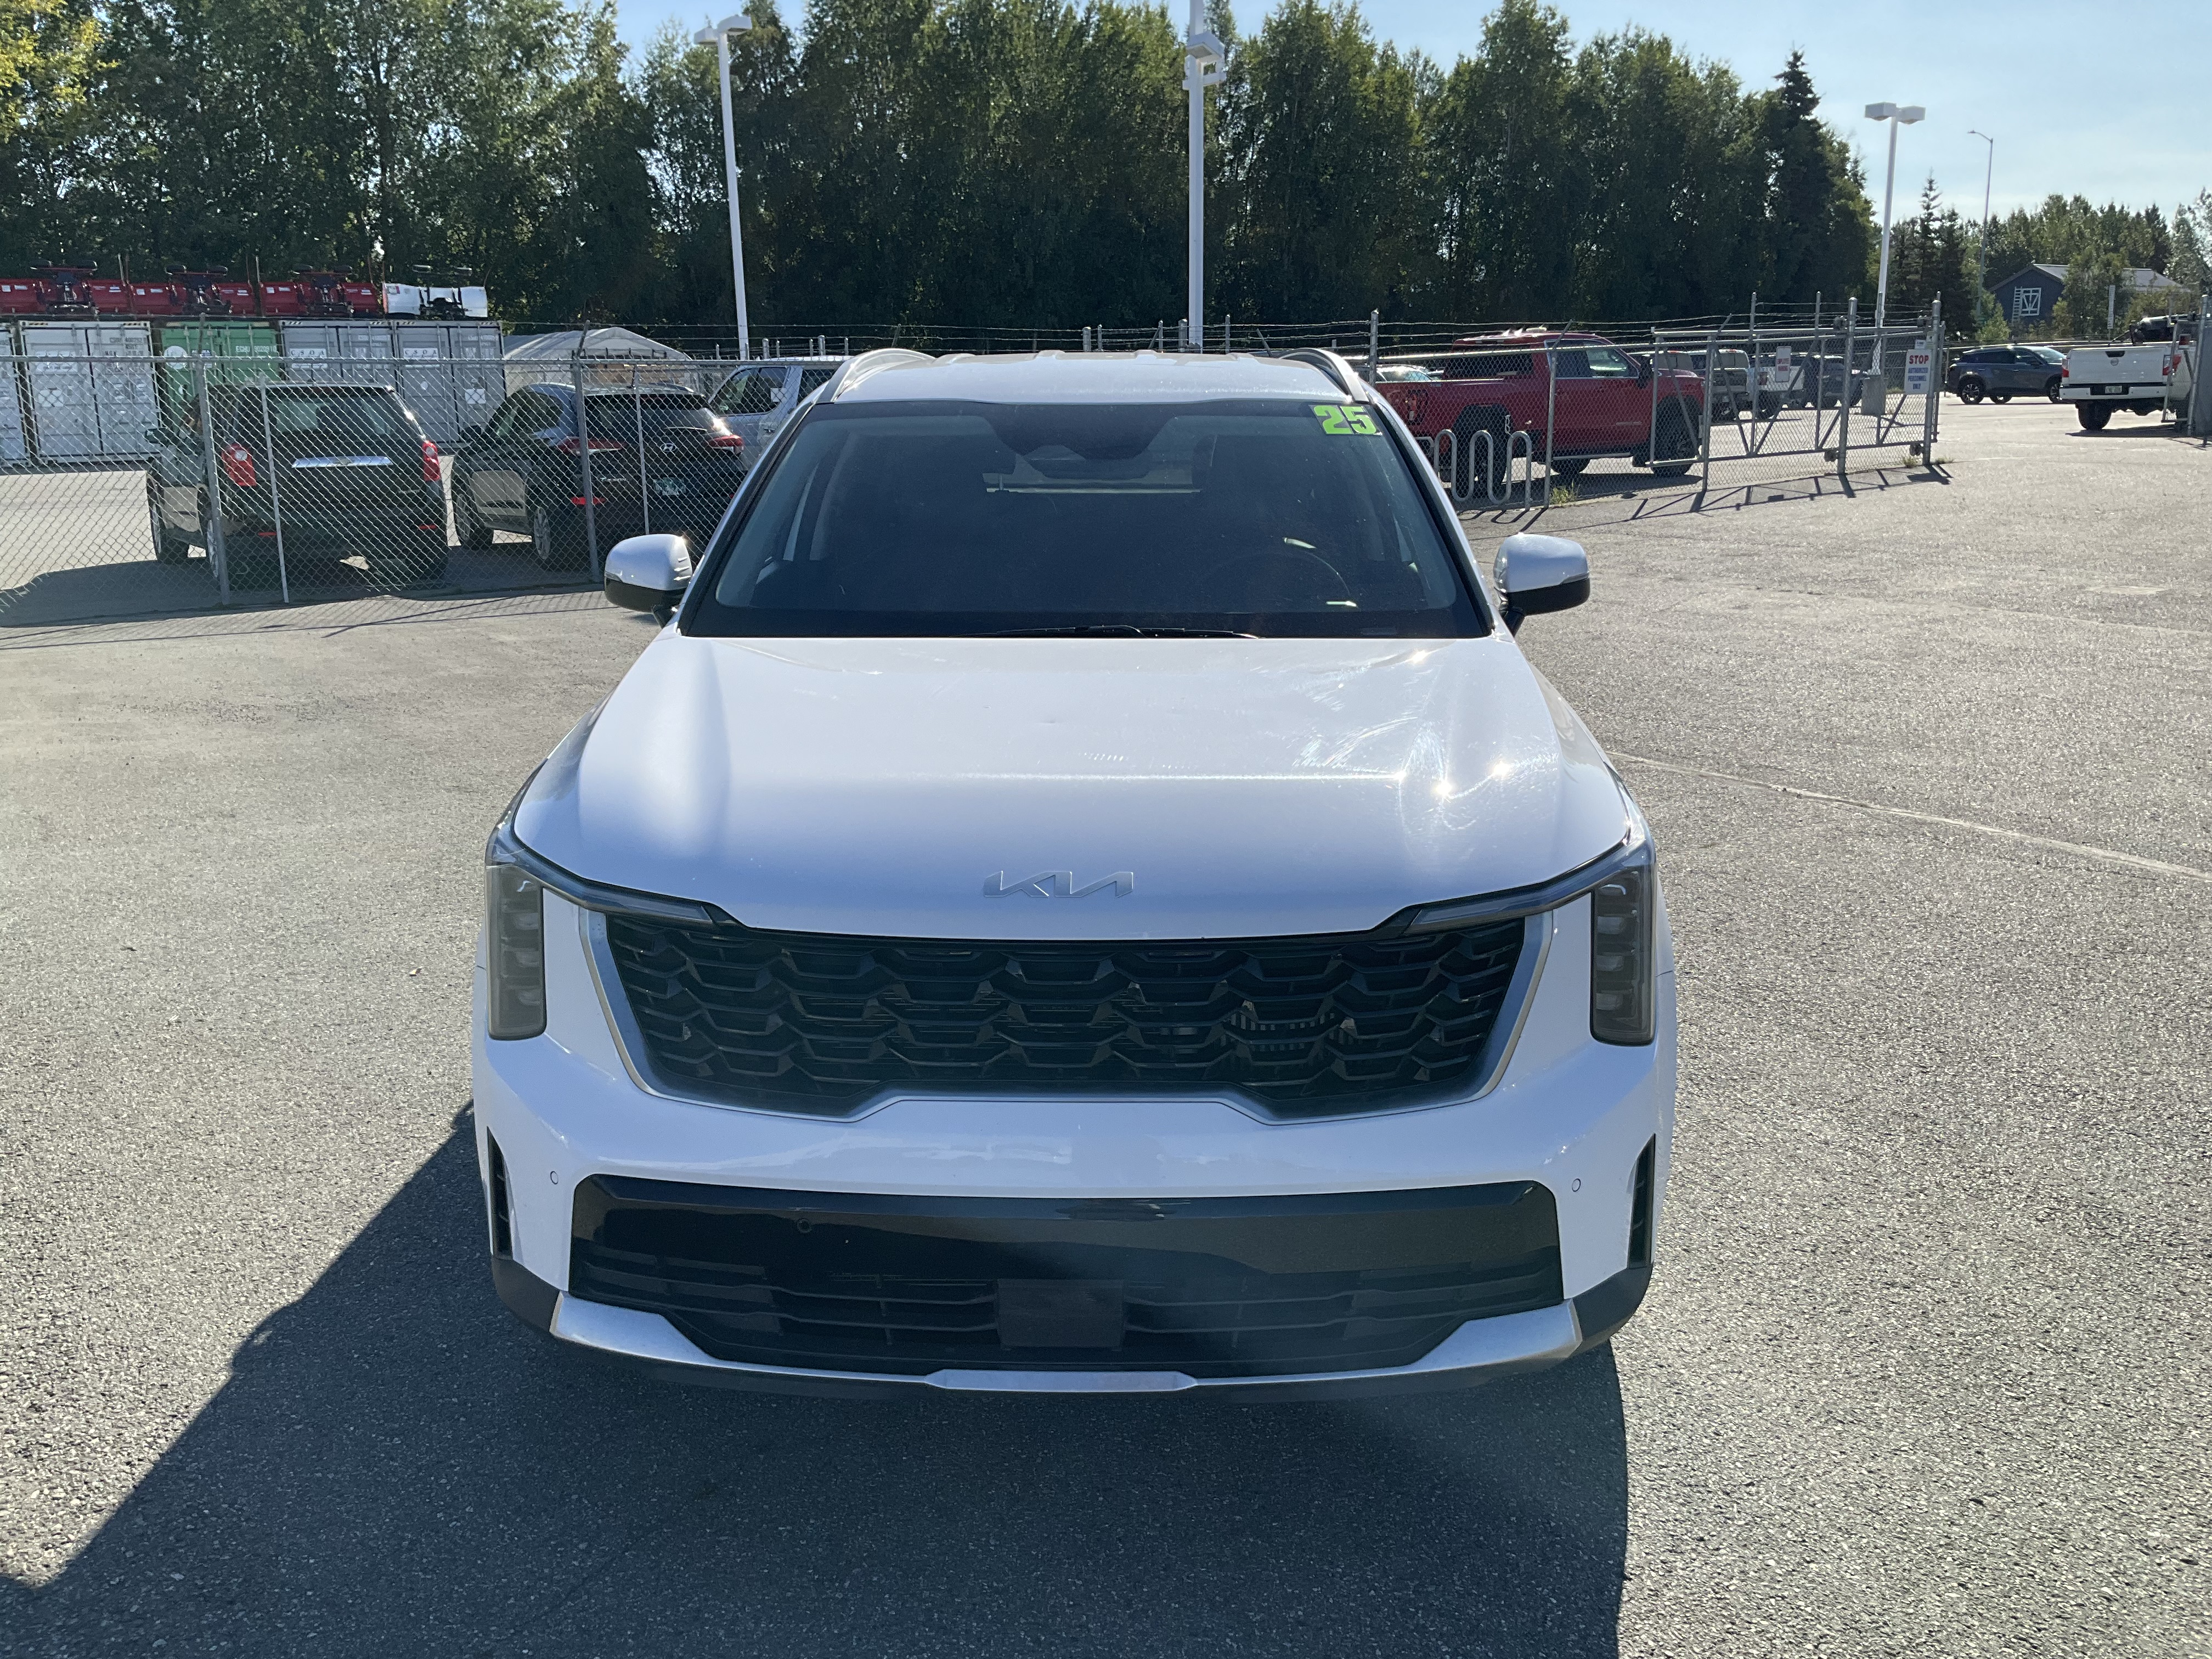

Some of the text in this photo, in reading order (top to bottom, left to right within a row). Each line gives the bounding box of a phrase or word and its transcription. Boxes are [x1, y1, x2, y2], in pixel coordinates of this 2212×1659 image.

[1909, 354, 1929, 364] STOP
[1313, 405, 1376, 435] 25
[983, 870, 1134, 898] KIA
